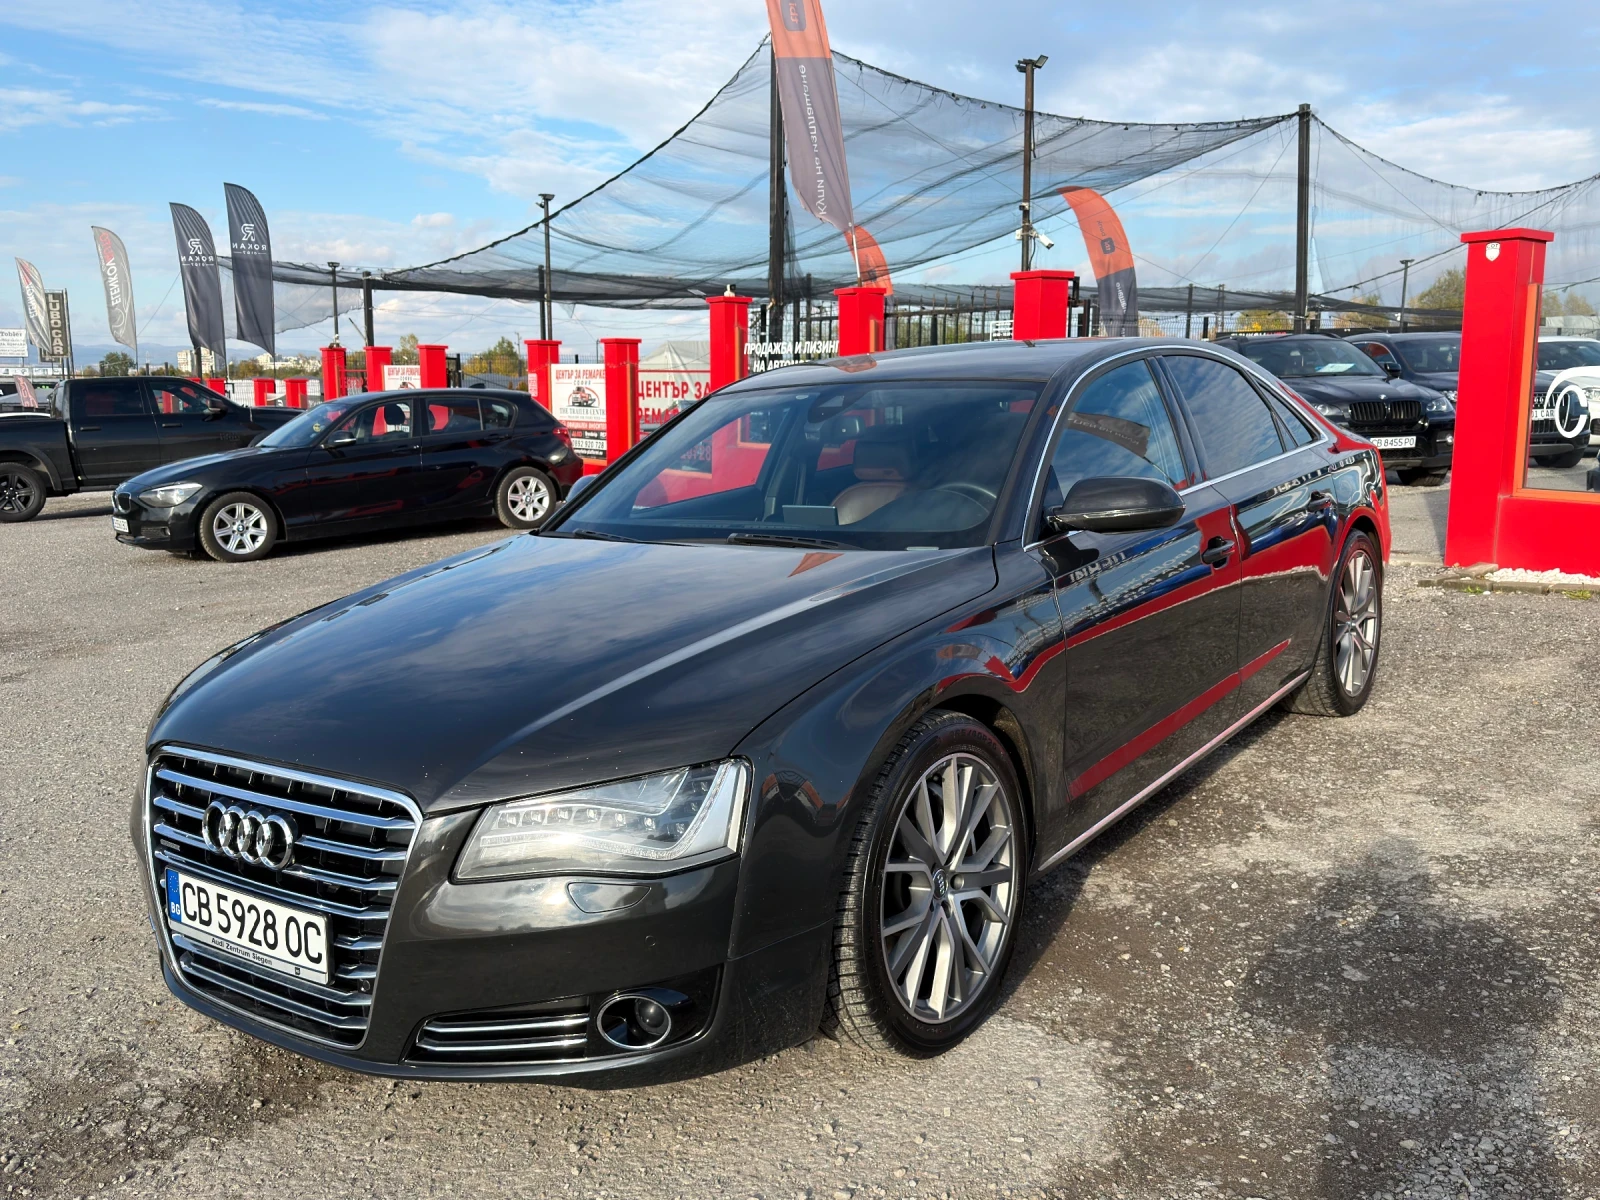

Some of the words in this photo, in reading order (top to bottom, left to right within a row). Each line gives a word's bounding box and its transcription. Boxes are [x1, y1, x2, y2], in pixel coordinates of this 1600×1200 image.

[743, 341, 793, 356] ПРОДАЖБА
[794, 342, 802, 354] И
[803, 340, 839, 353] ЛИЗИНГ
[753, 359, 766, 372] НА
[637, 381, 689, 400] ЦЕНТЪР
[1383, 438, 1403, 447] 8455
[170, 901, 181, 915] BG
[182, 881, 212, 927] CB
[216, 893, 279, 951] 5928
[285, 915, 323, 965] OC
[211, 937, 225, 948] Audi
[225, 942, 251, 958] Zentrum
[251, 952, 273, 966] Siegen
